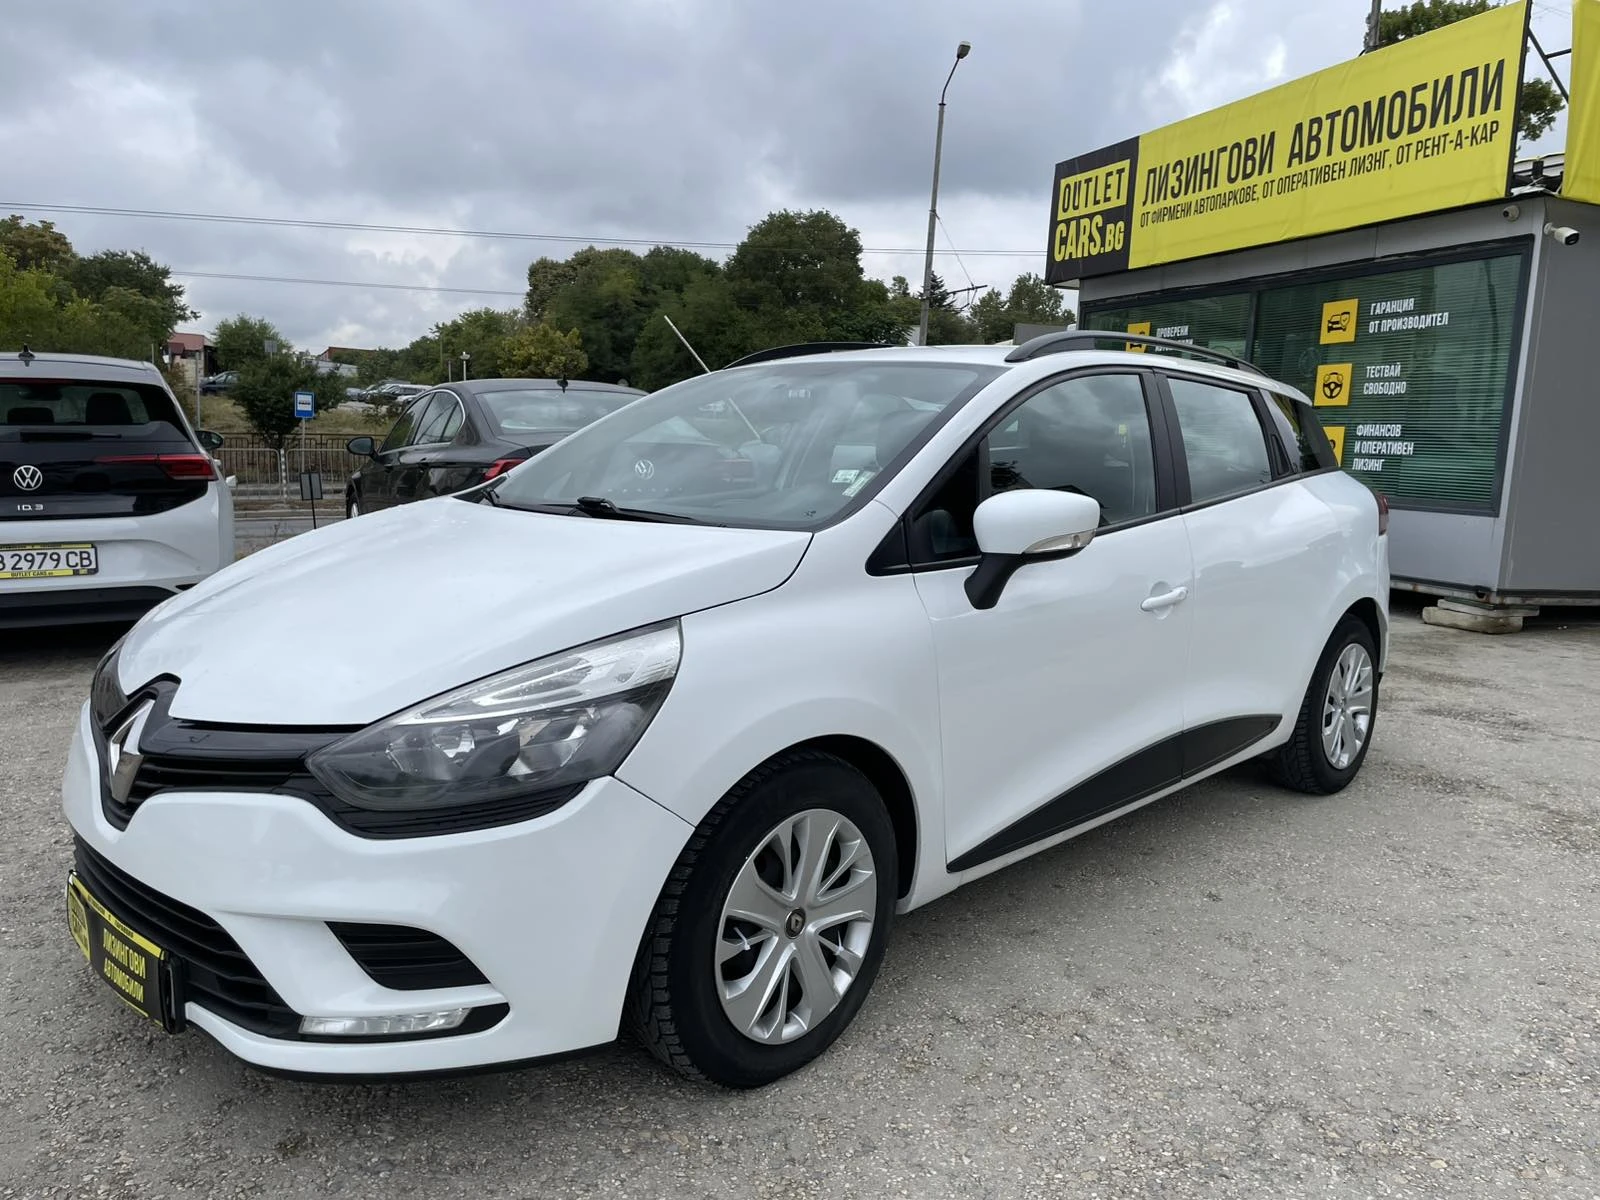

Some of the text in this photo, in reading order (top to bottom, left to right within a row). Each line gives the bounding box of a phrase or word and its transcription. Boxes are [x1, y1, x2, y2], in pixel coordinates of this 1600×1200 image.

[1142, 58, 1505, 207] ЛИЗИНГОВИ АВТОМОБИЛИ
[1140, 211, 1151, 228] ОТ
[1151, 204, 1192, 224] ФИРМЕНИ
[1193, 184, 1260, 216] АВТОПАРКОВЕ,
[1262, 180, 1275, 199] ОТ
[1277, 160, 1346, 195] ОПЕРАТИВЕН
[1396, 143, 1413, 165] ОТ
[1415, 120, 1499, 161] РЕНТ-А-КАР
[1062, 167, 1126, 213] OUTLET
[1054, 214, 1125, 262] CARS.BG
[1370, 298, 1415, 315] ГАРАНЦИЯ
[1368, 312, 1449, 333] ОТ ПРОИЗВОДИТЕЛ
[1156, 325, 1189, 338] ПРОВЕРЕНИ
[1366, 362, 1401, 378] ТЕСТВАЙ
[1363, 381, 1407, 395] СВОБОДНО
[1356, 424, 1402, 437] ФИНАНСОВ
[1354, 440, 1414, 455] И ОПЕРАТИВЕН
[1352, 458, 1385, 471] ЛИЗИНГ
[10, 552, 61, 571] 2979
